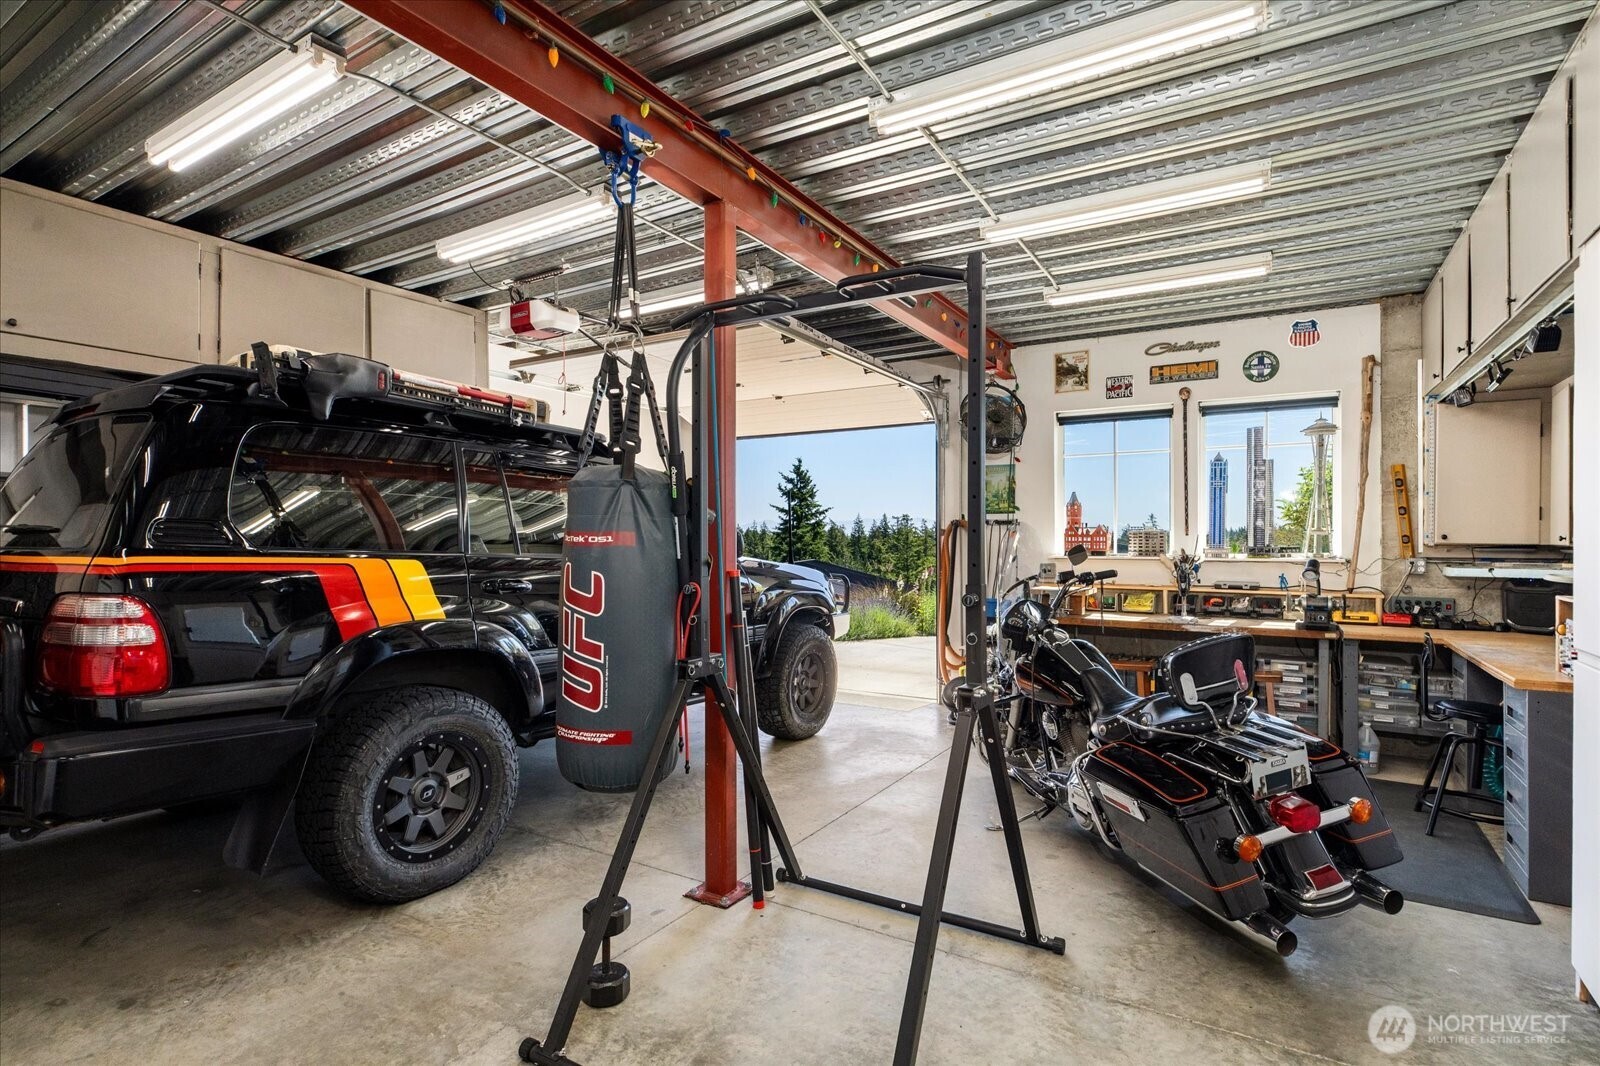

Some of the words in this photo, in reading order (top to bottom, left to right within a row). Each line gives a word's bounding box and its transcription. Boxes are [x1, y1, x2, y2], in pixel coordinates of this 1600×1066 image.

[1144, 341, 1221, 356] Challenger
[1151, 360, 1216, 377] HEMI
[1106, 376, 1133, 389] WESTERN
[1106, 386, 1133, 398] PACIFIC
[562, 562, 605, 713] UFC
